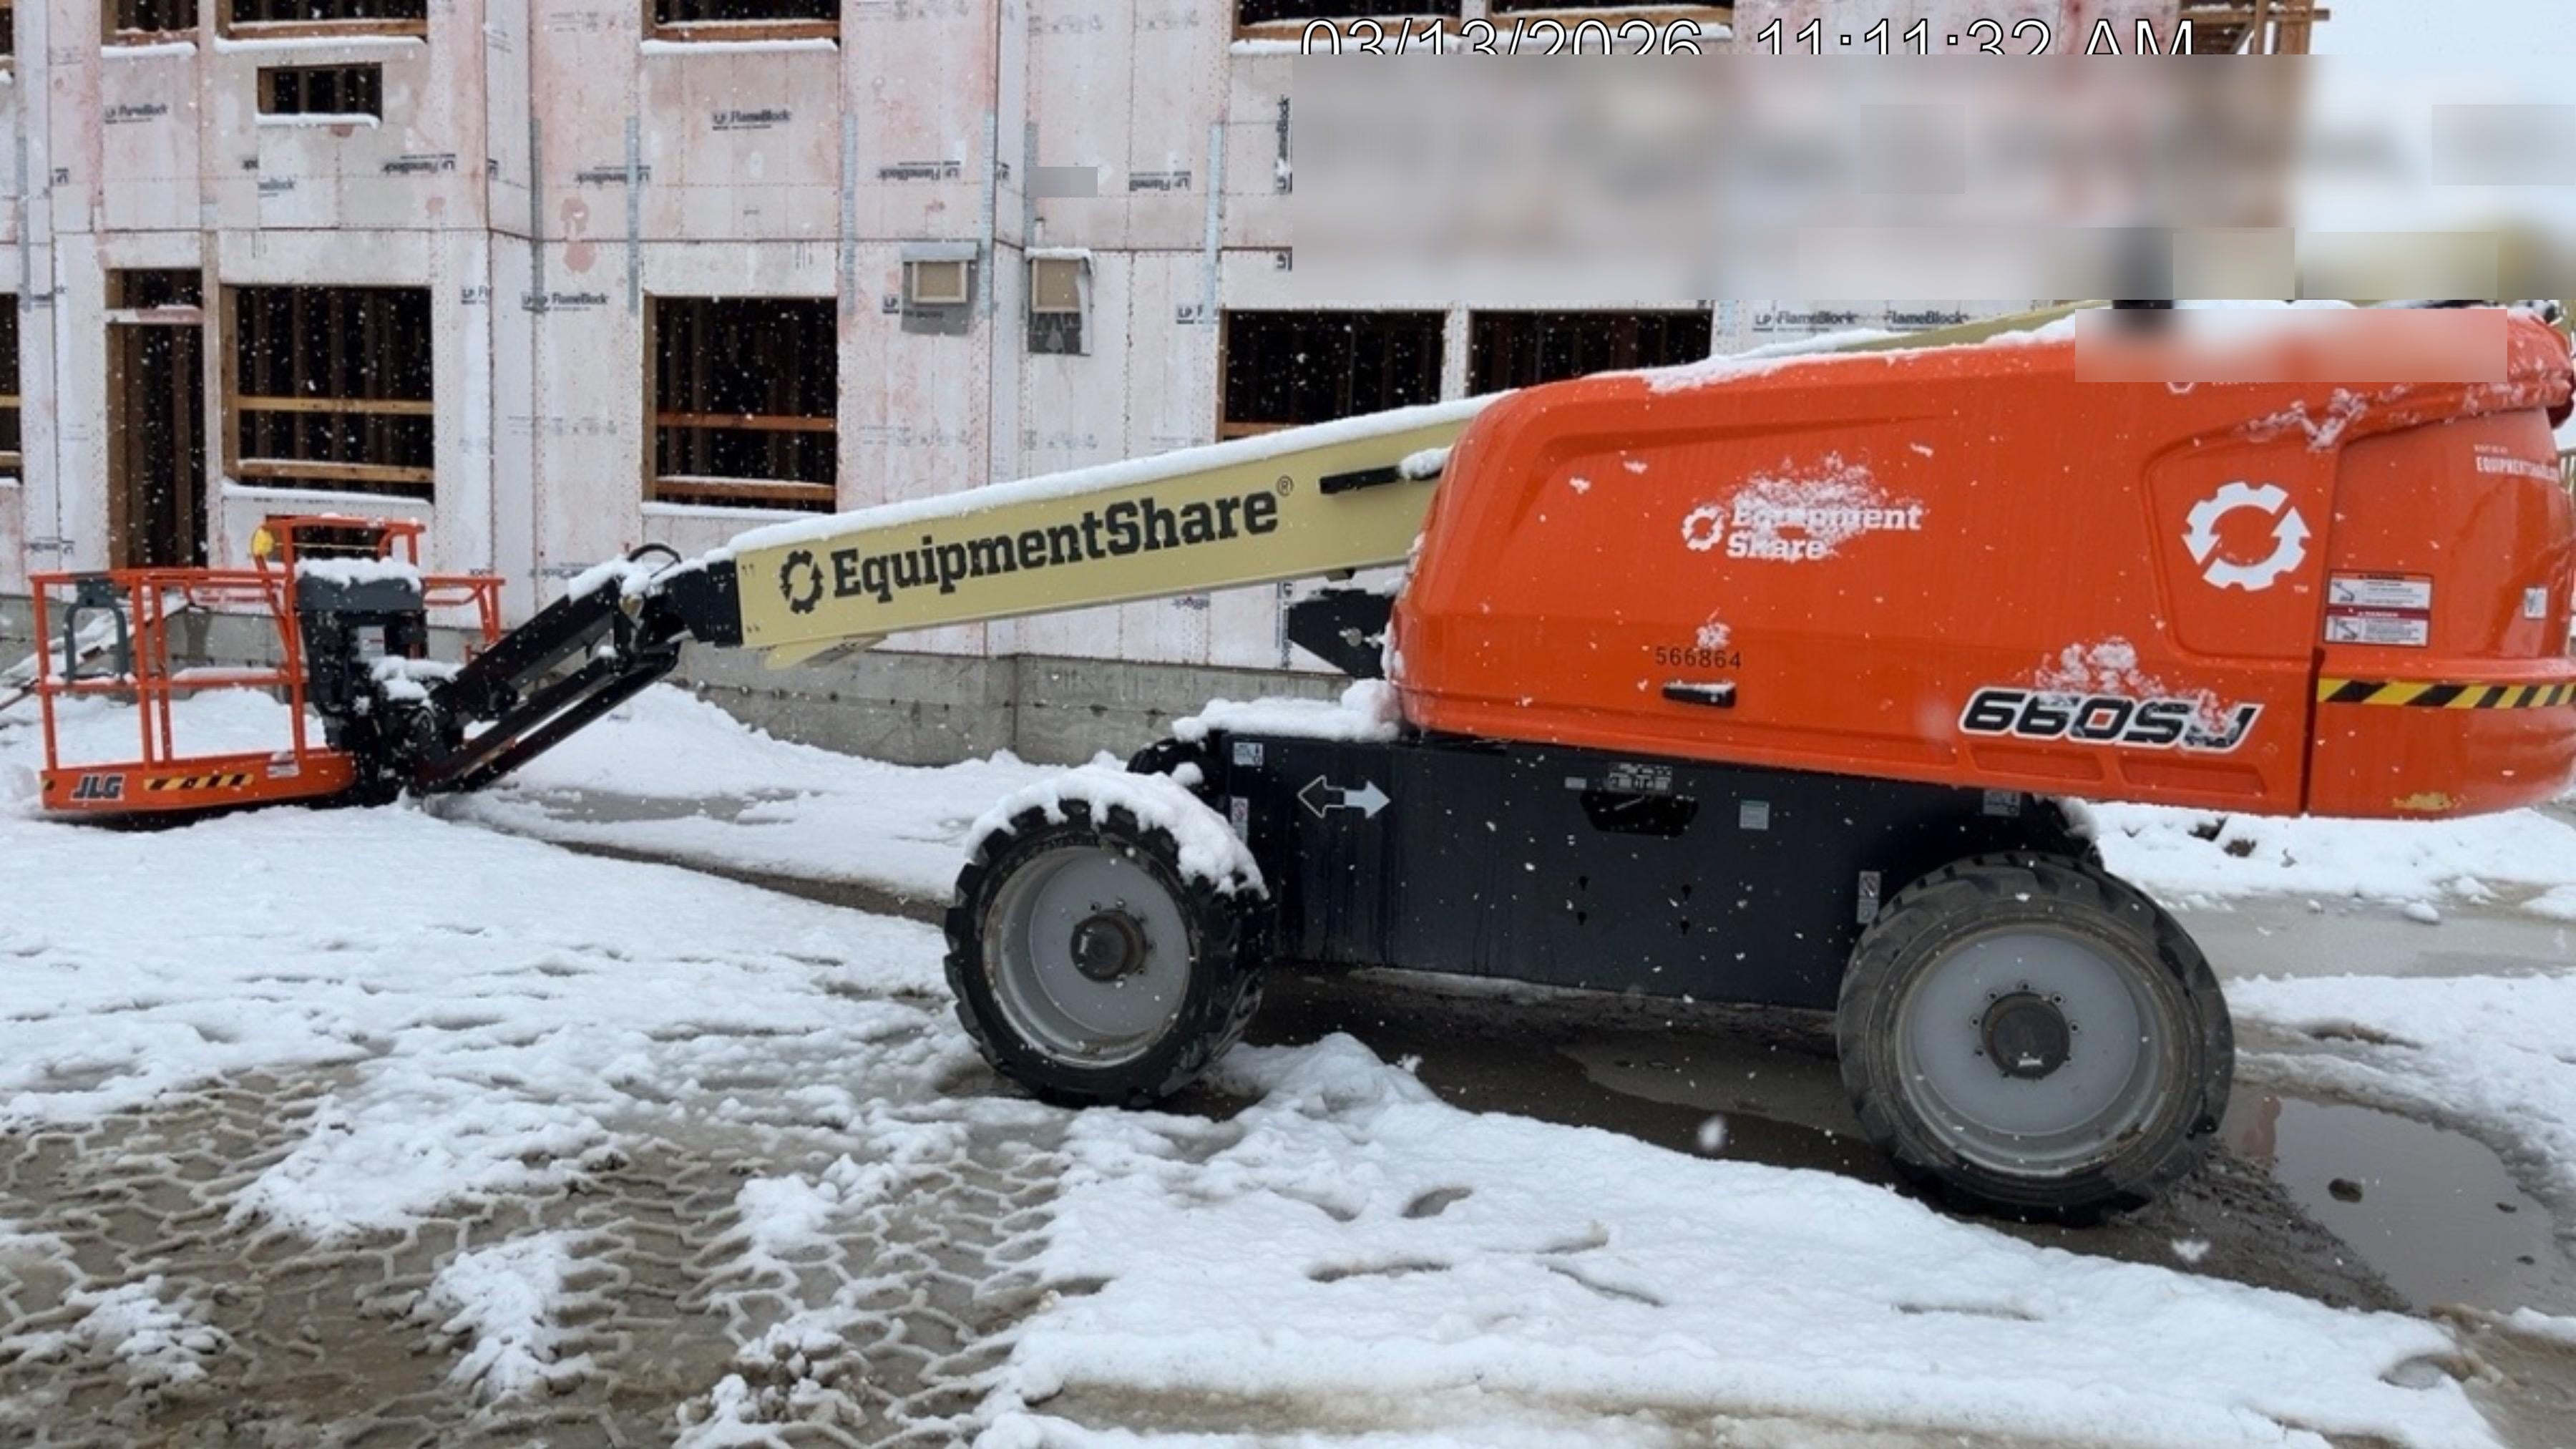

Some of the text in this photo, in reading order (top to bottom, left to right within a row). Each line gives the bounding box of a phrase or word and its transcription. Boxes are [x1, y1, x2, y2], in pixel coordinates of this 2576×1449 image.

[1656, 647, 1742, 670] 566864
[1960, 688, 2263, 752] 660SJ
[70, 774, 125, 801] JLG
